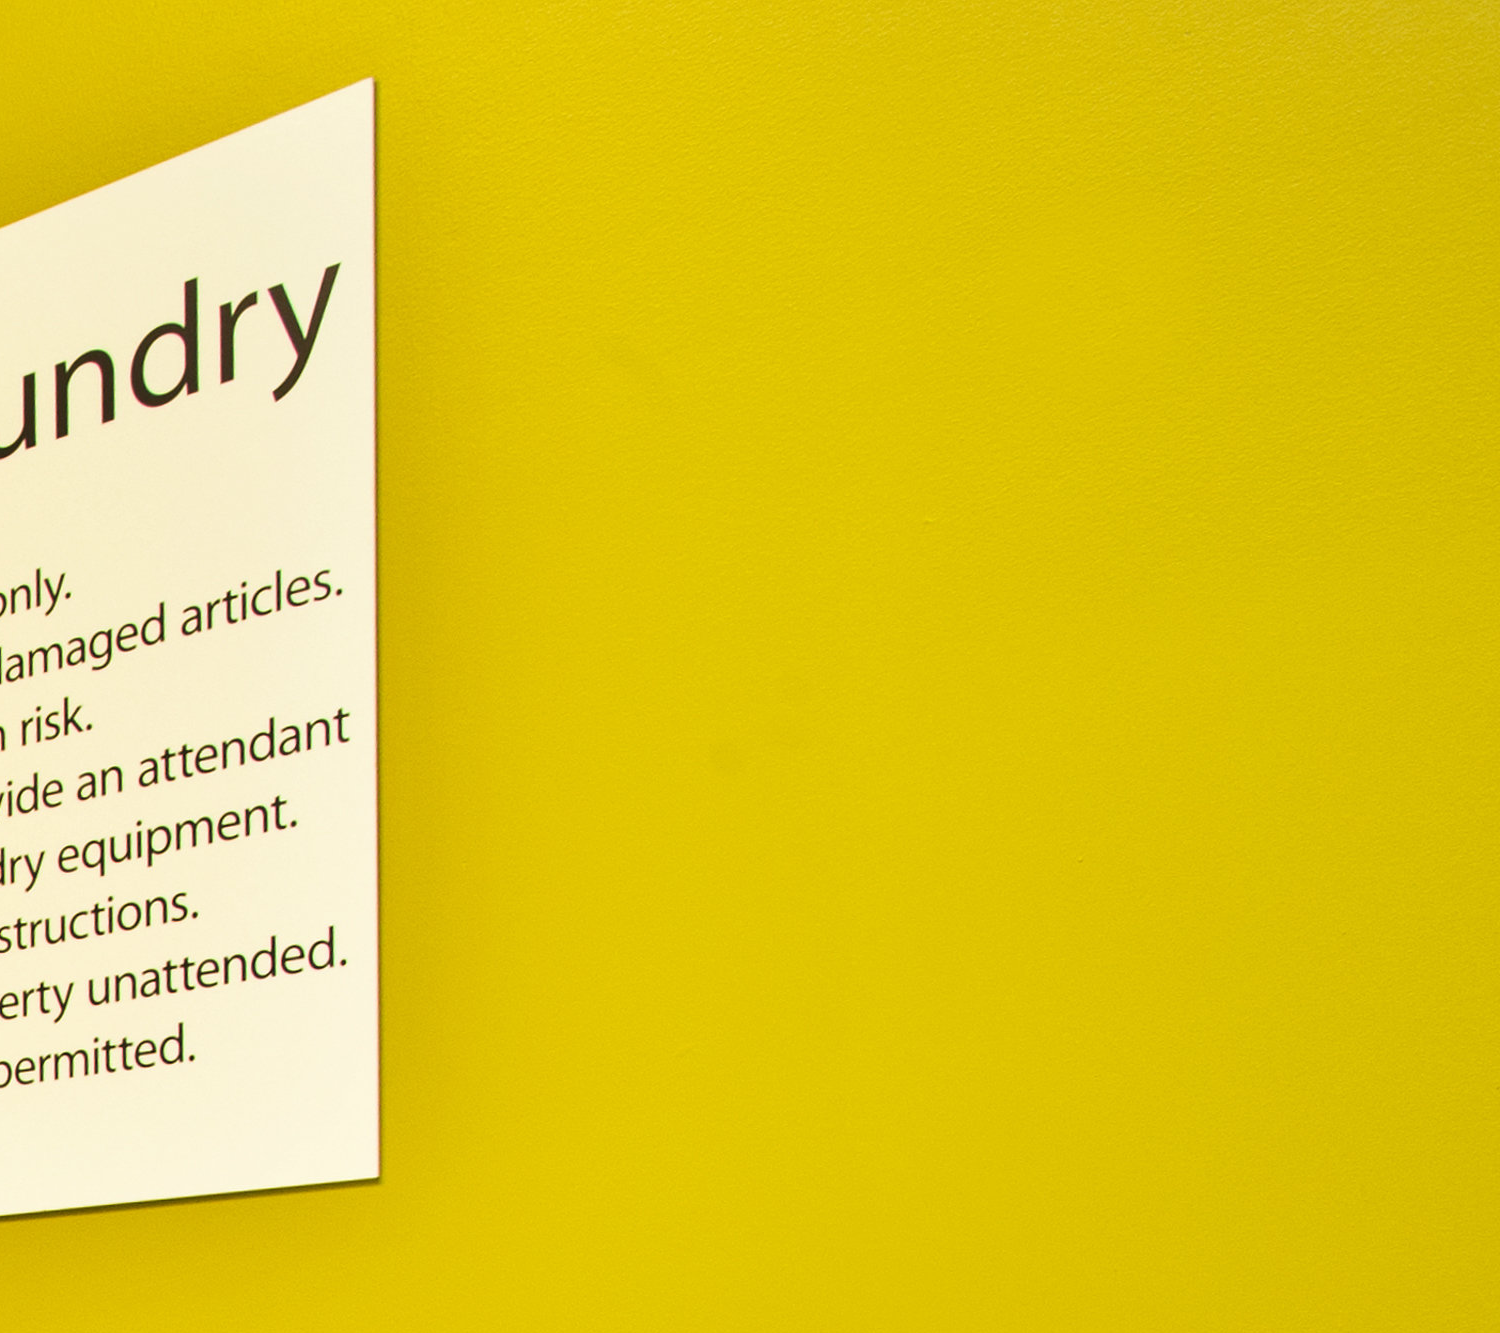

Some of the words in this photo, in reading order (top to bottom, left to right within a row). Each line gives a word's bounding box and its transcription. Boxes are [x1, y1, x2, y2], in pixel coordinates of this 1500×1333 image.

[181, 569, 343, 637] articles.
[21, 696, 93, 747] risk.
[76, 765, 123, 802] an
[138, 708, 350, 788] attendant
[57, 795, 298, 877] equipment.
[88, 925, 347, 1006] unattended.
